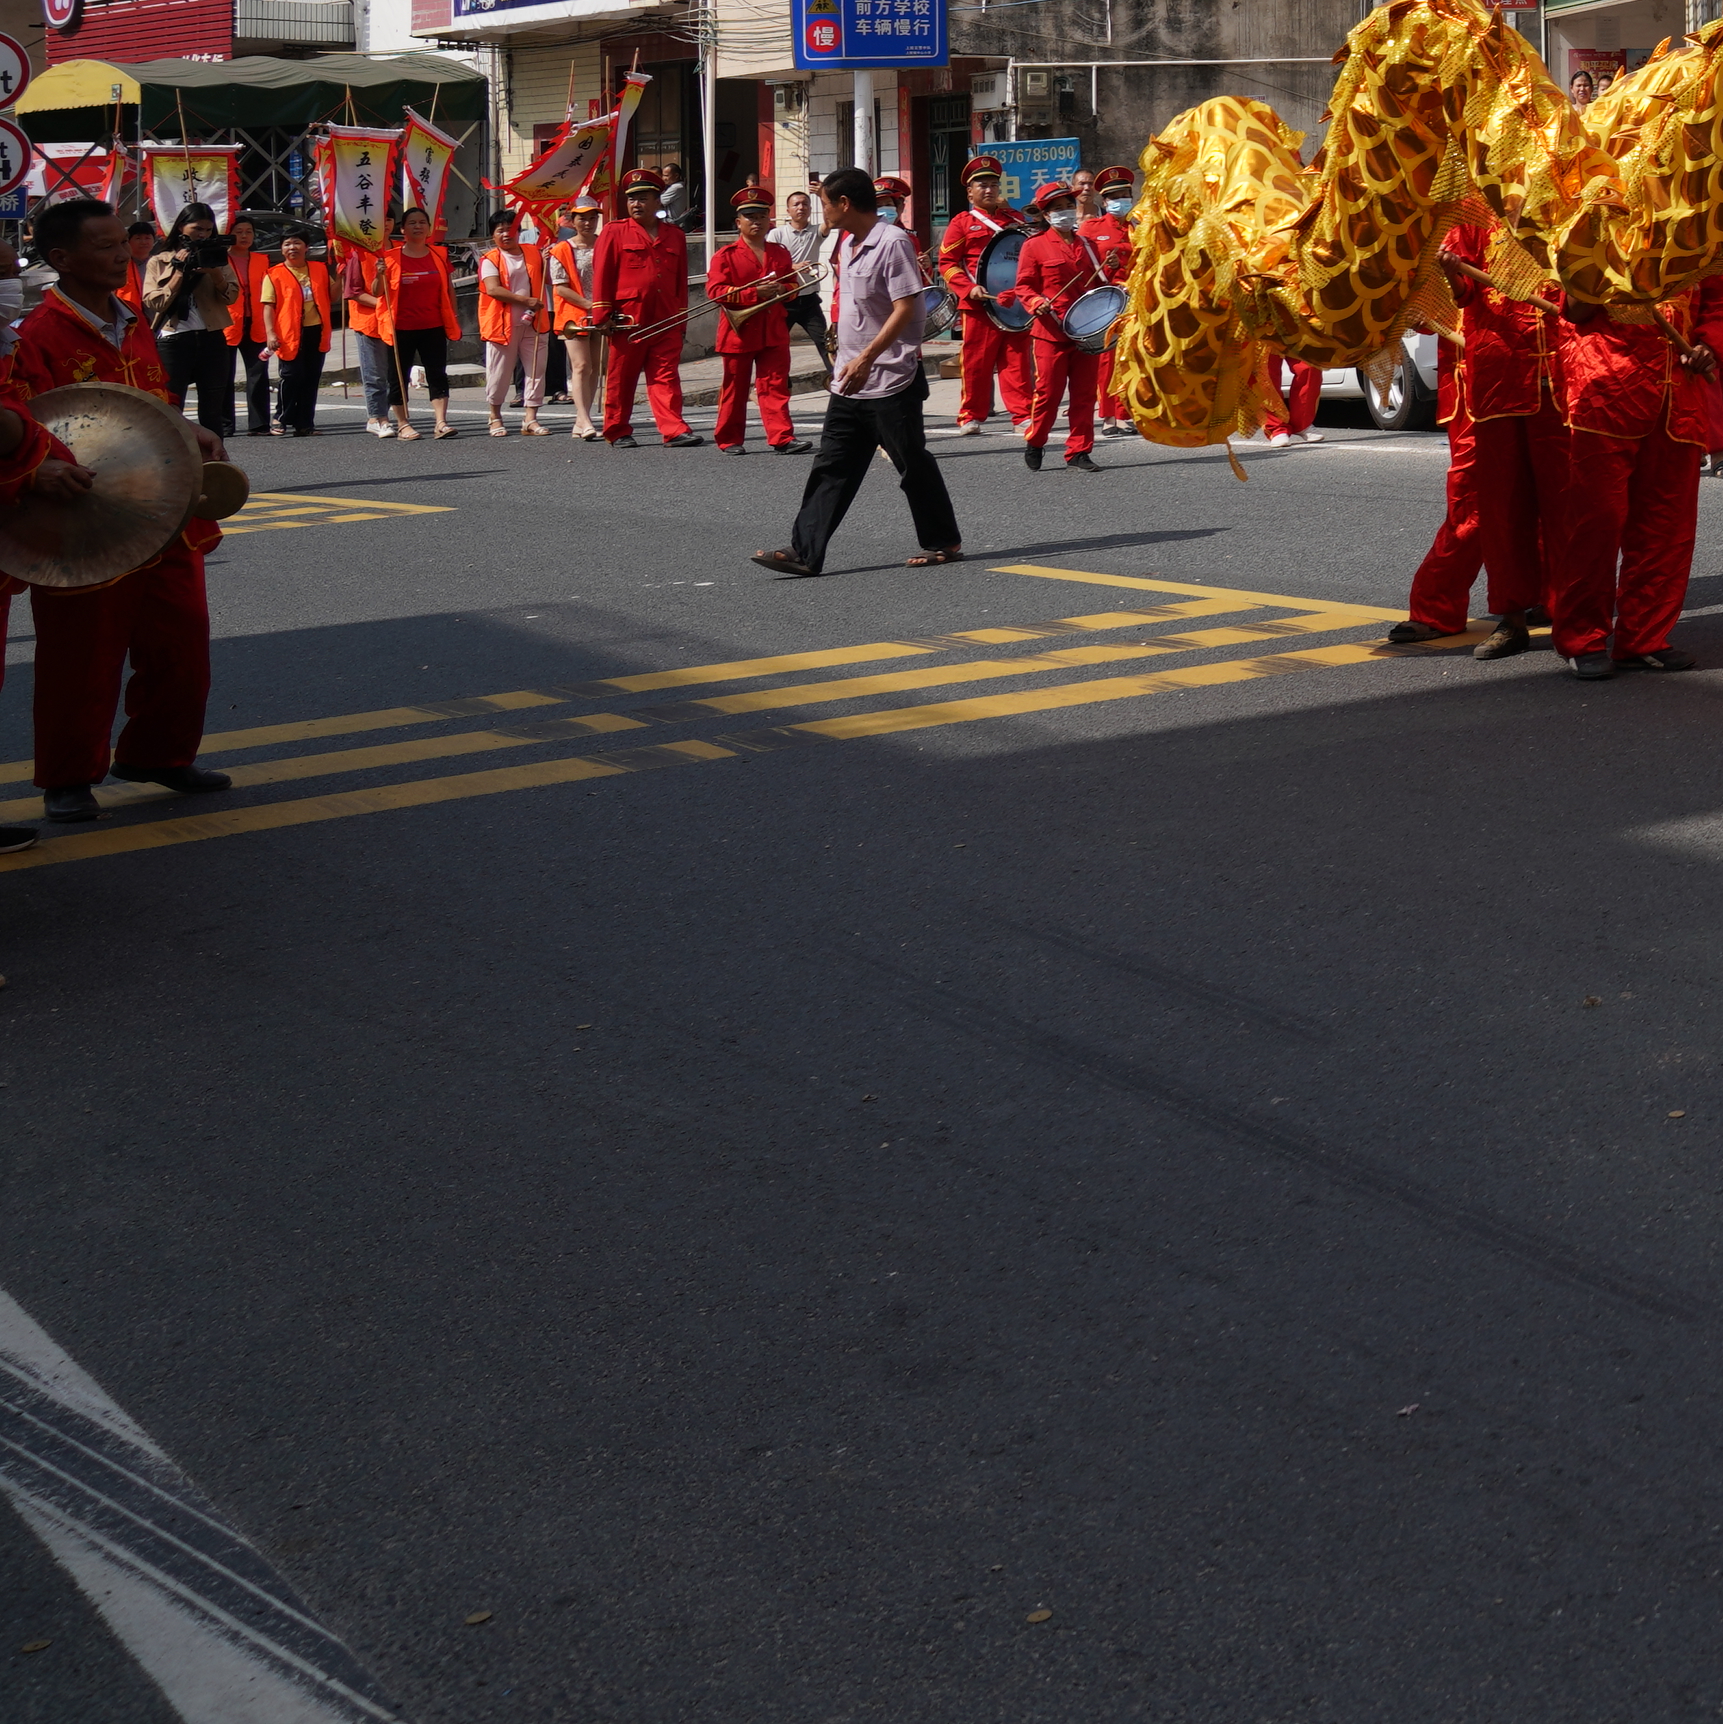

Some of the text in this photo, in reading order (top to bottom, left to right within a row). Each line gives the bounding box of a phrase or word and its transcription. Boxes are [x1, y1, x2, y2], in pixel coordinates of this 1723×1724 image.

[813, 26, 834, 46] 慢
[855, 19, 930, 36] 车辆慢行
[354, 151, 377, 236] 五谷丰登
